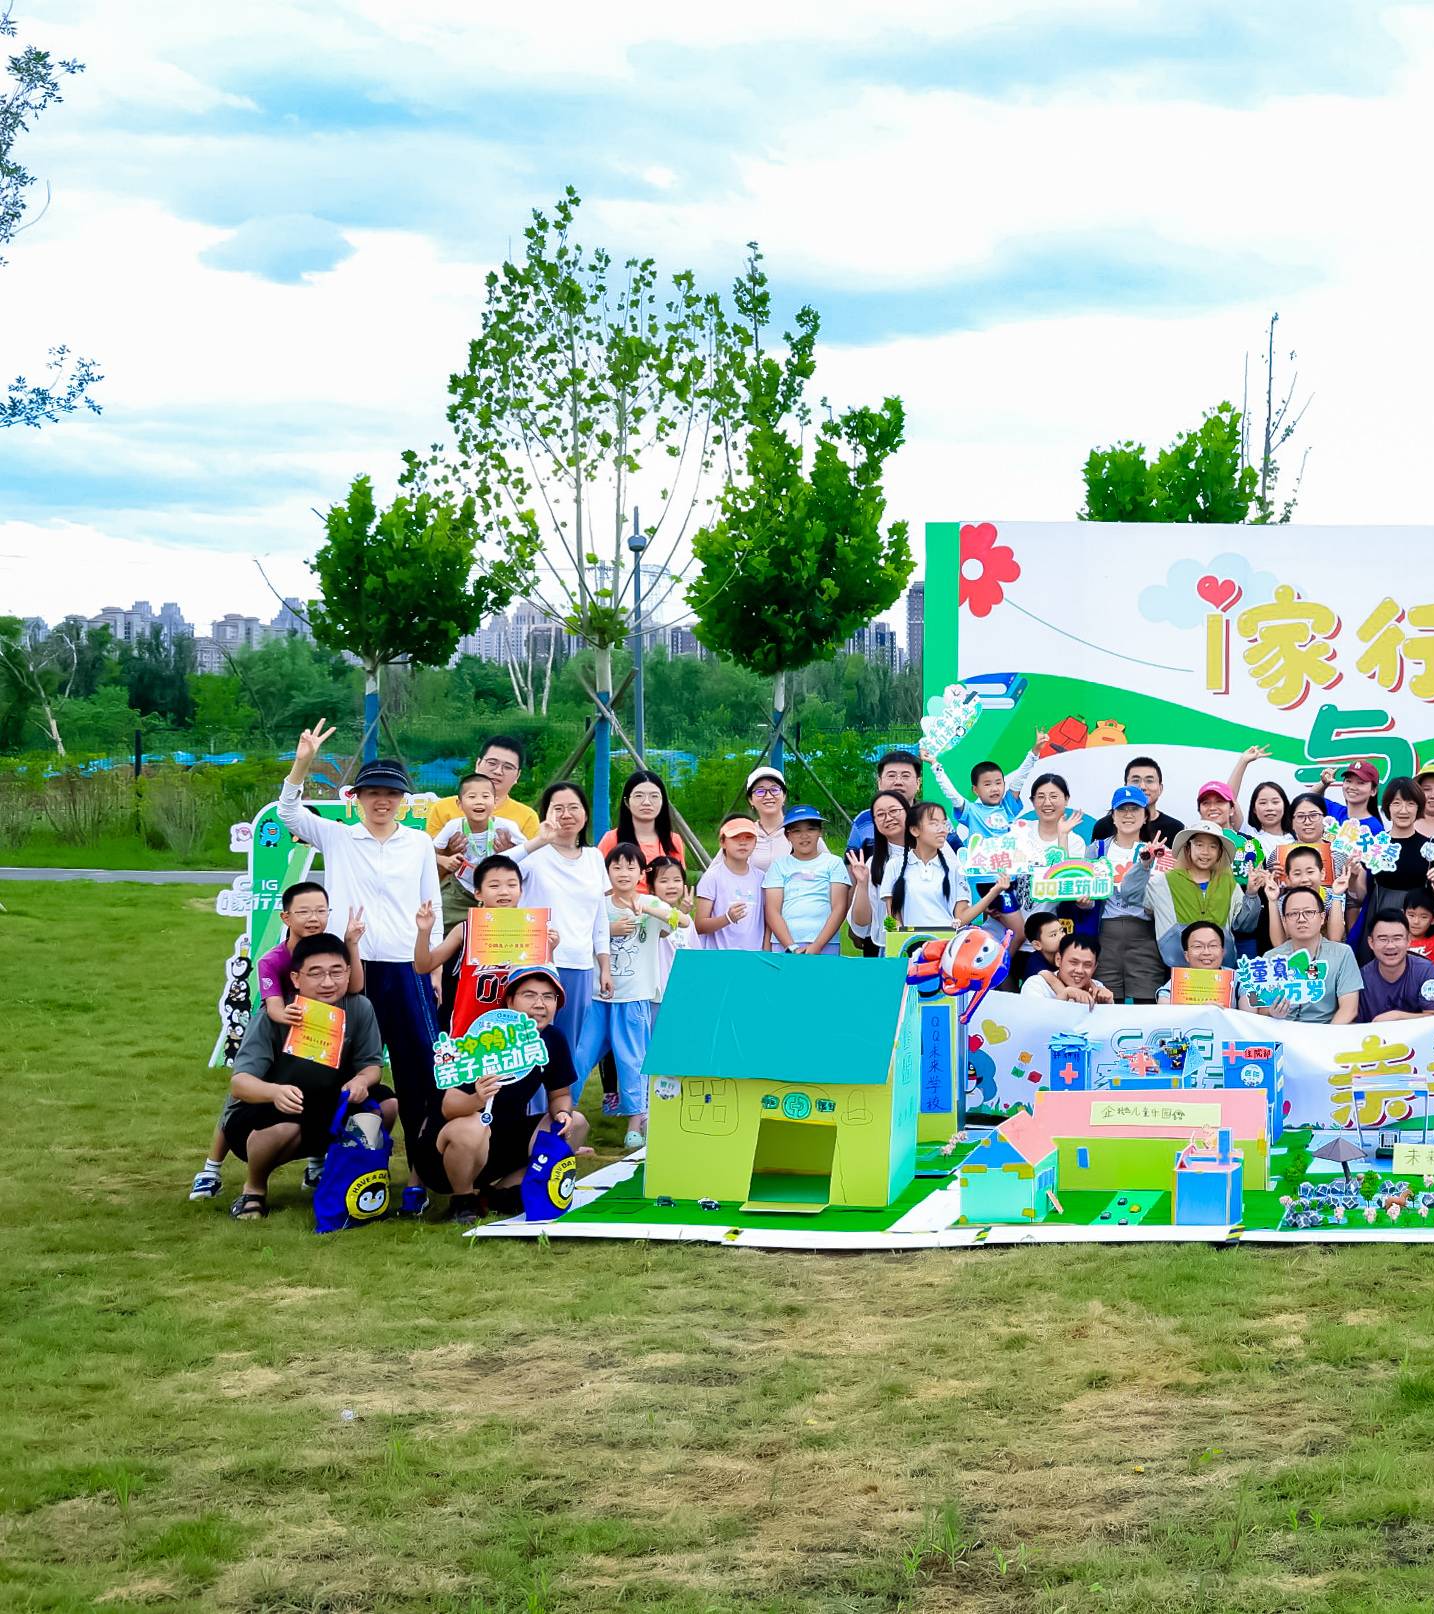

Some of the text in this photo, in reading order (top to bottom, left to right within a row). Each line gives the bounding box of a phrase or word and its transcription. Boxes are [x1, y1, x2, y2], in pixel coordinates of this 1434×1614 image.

[1250, 957, 1288, 983] 童真
[1283, 980, 1324, 1002] 万岁
[437, 1042, 545, 1087] 亲子总动员
[926, 1016, 947, 1111] QQ未来学校
[352, 1176, 372, 1194] HAVE
